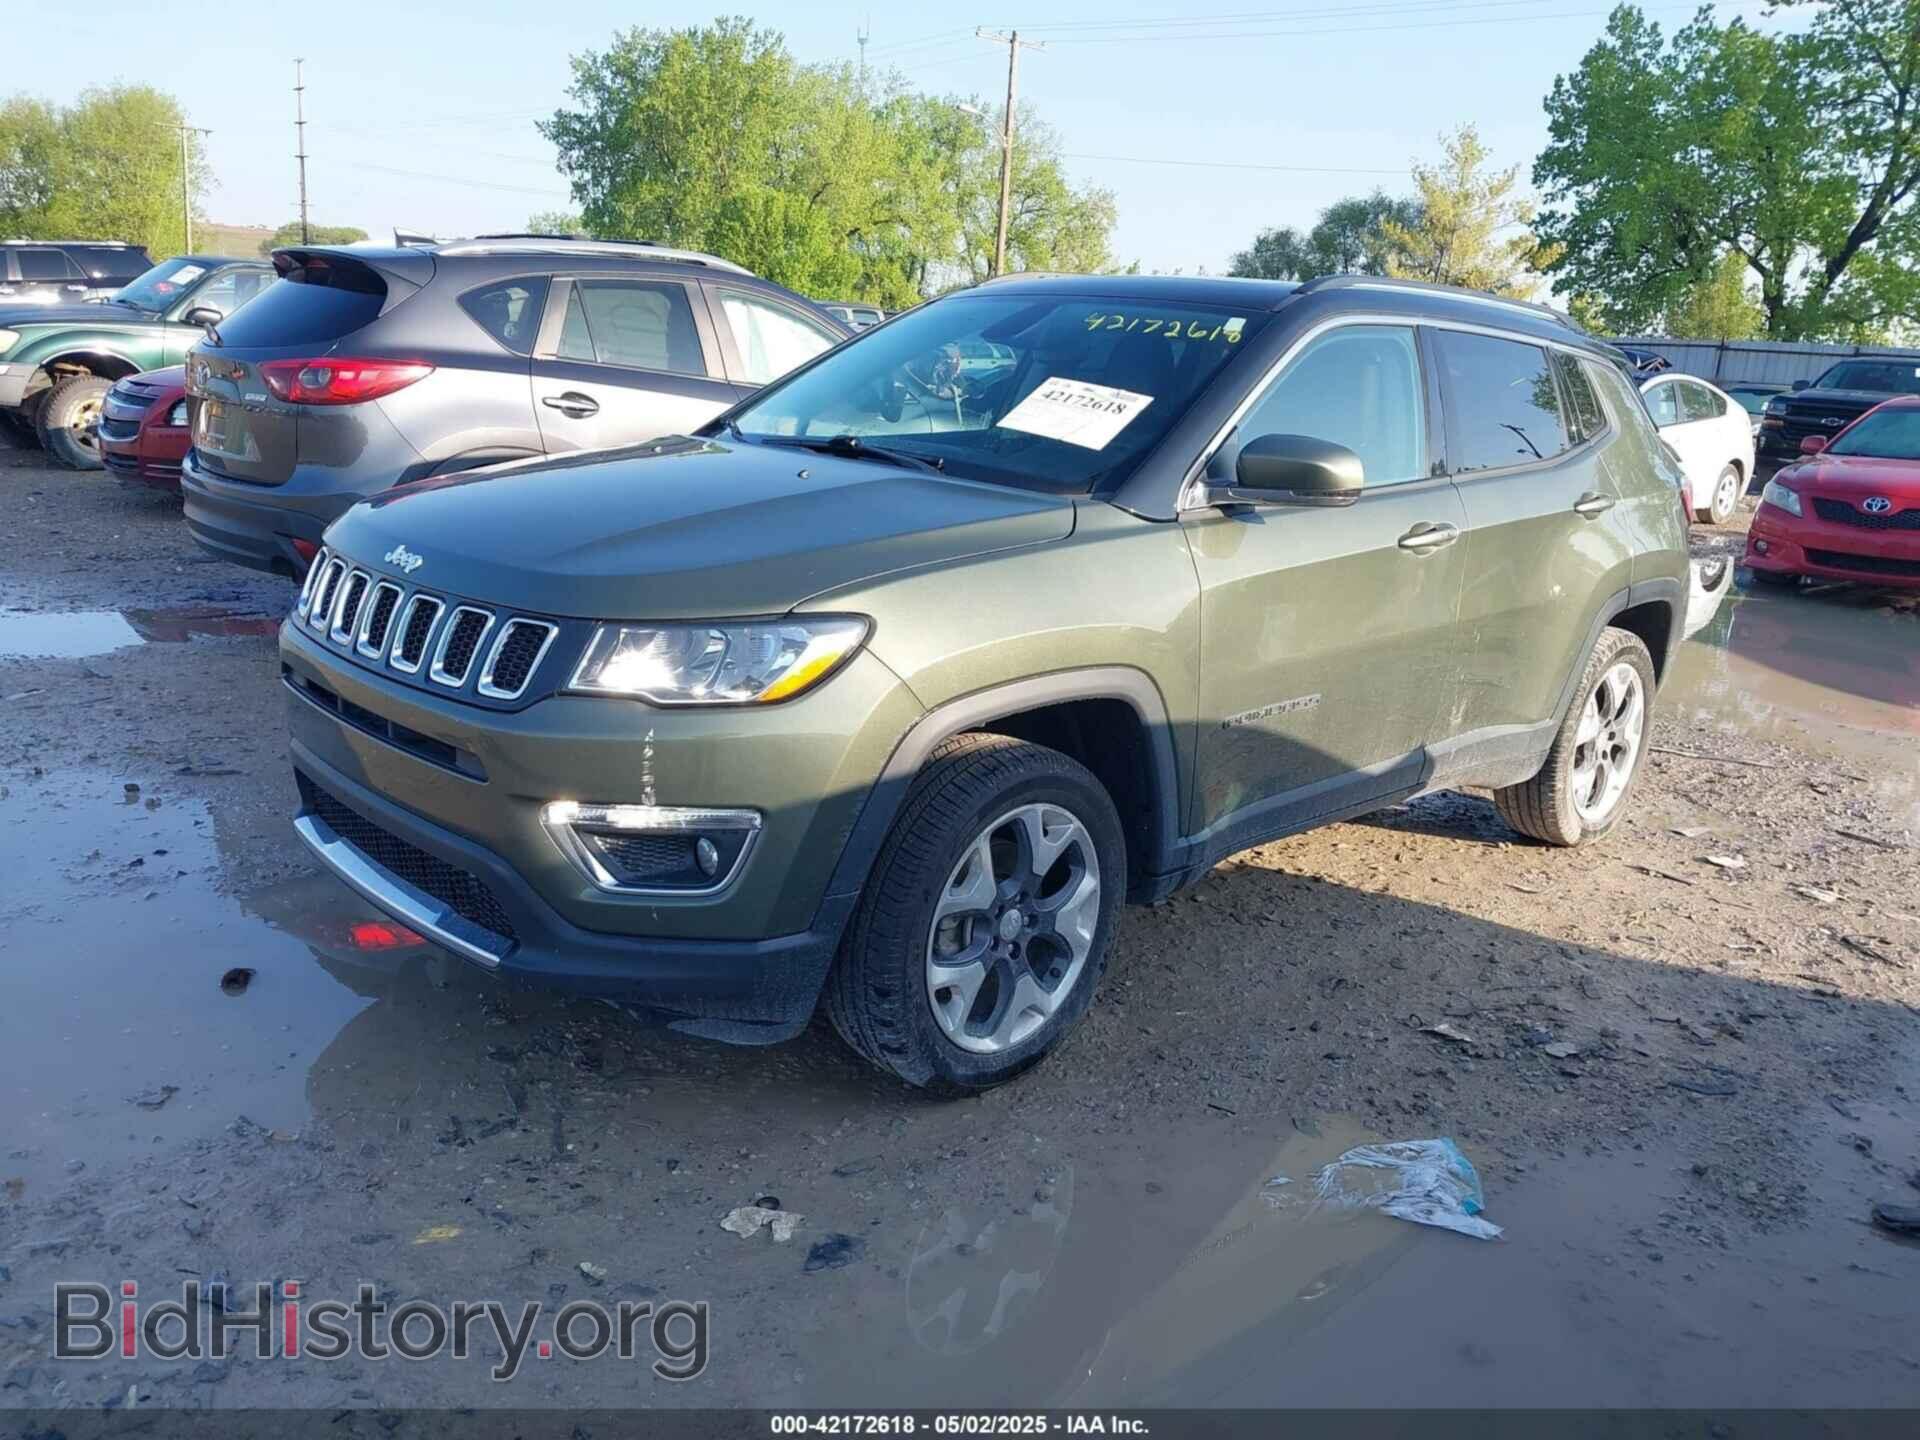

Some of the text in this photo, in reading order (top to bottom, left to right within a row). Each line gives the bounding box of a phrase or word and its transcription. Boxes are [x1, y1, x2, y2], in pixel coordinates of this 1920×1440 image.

[1084, 312, 1243, 344] 42172618
[1041, 389, 1128, 415] 42172618
[383, 544, 424, 574] Jeep
